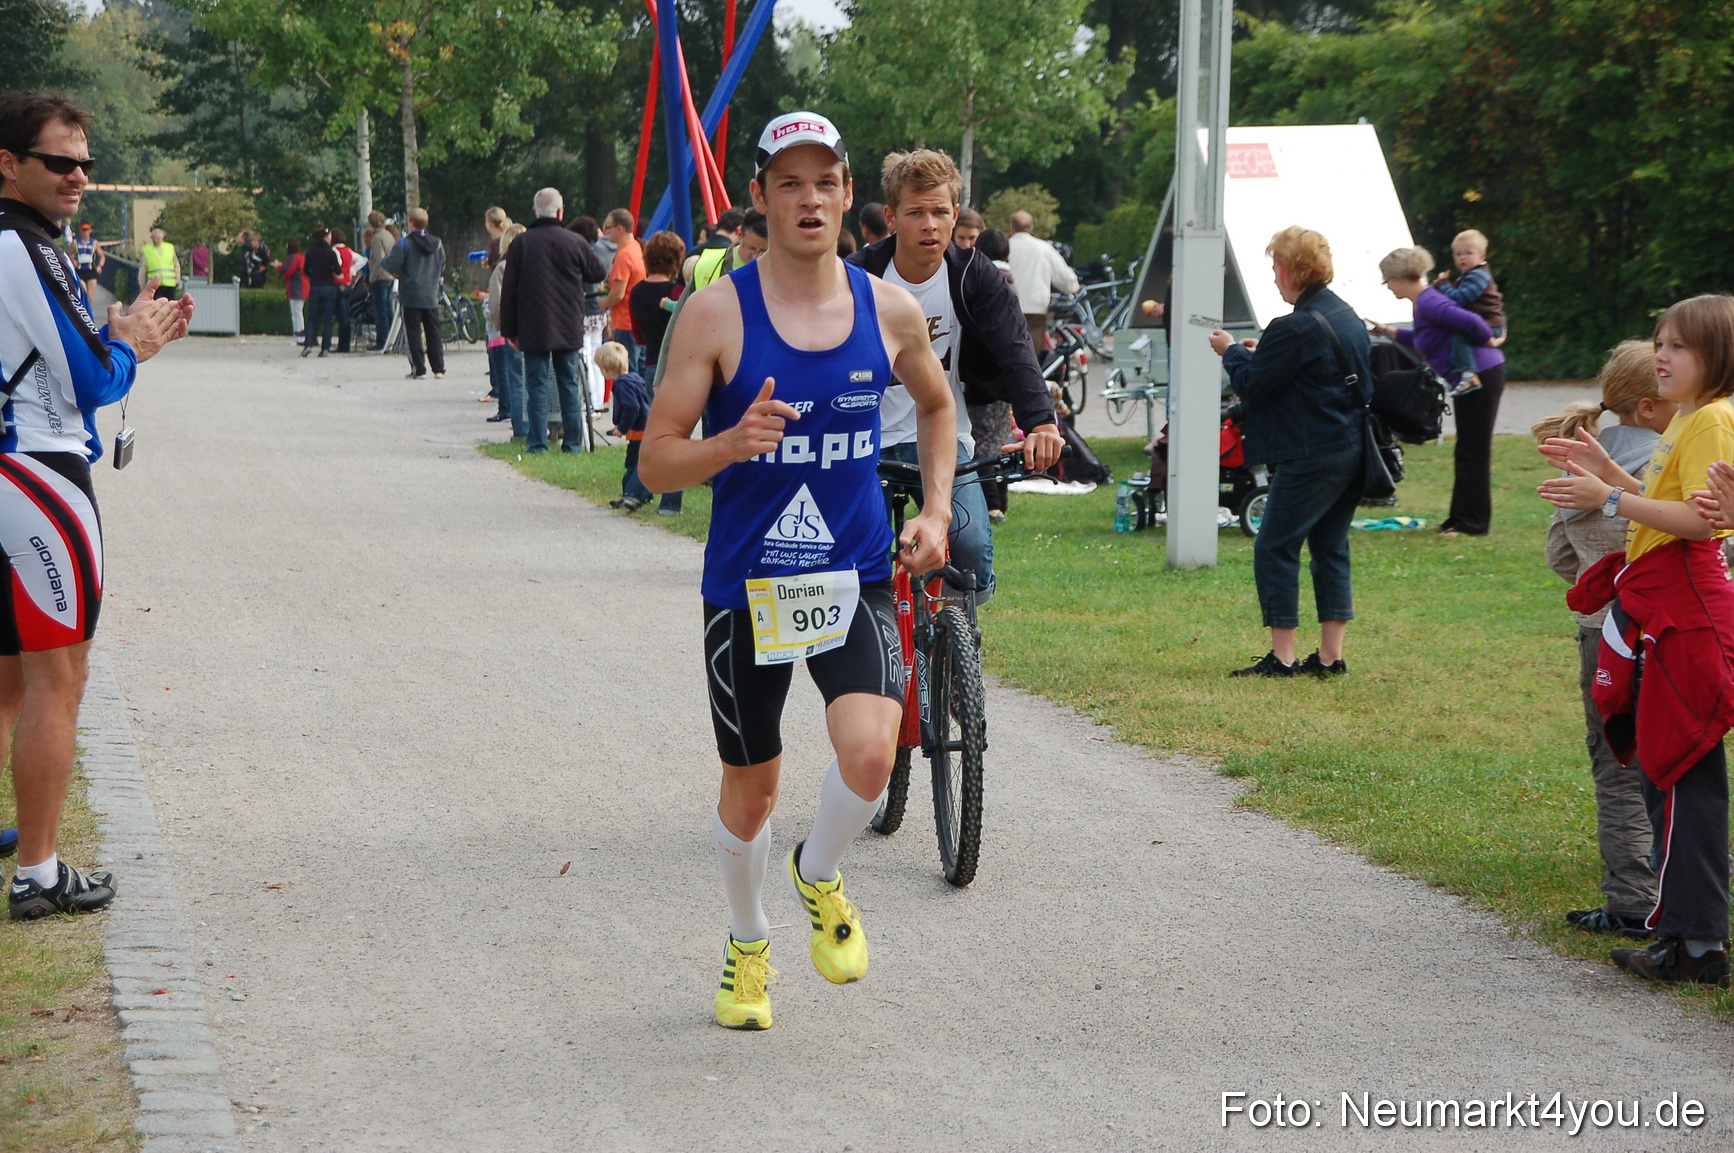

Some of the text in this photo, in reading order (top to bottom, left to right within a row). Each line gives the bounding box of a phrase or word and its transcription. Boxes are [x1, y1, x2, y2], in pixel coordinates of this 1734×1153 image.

[29, 535, 68, 612] Giordana
[777, 583, 825, 600] Dorian
[757, 611, 764, 623] A
[792, 605, 841, 632] 903
